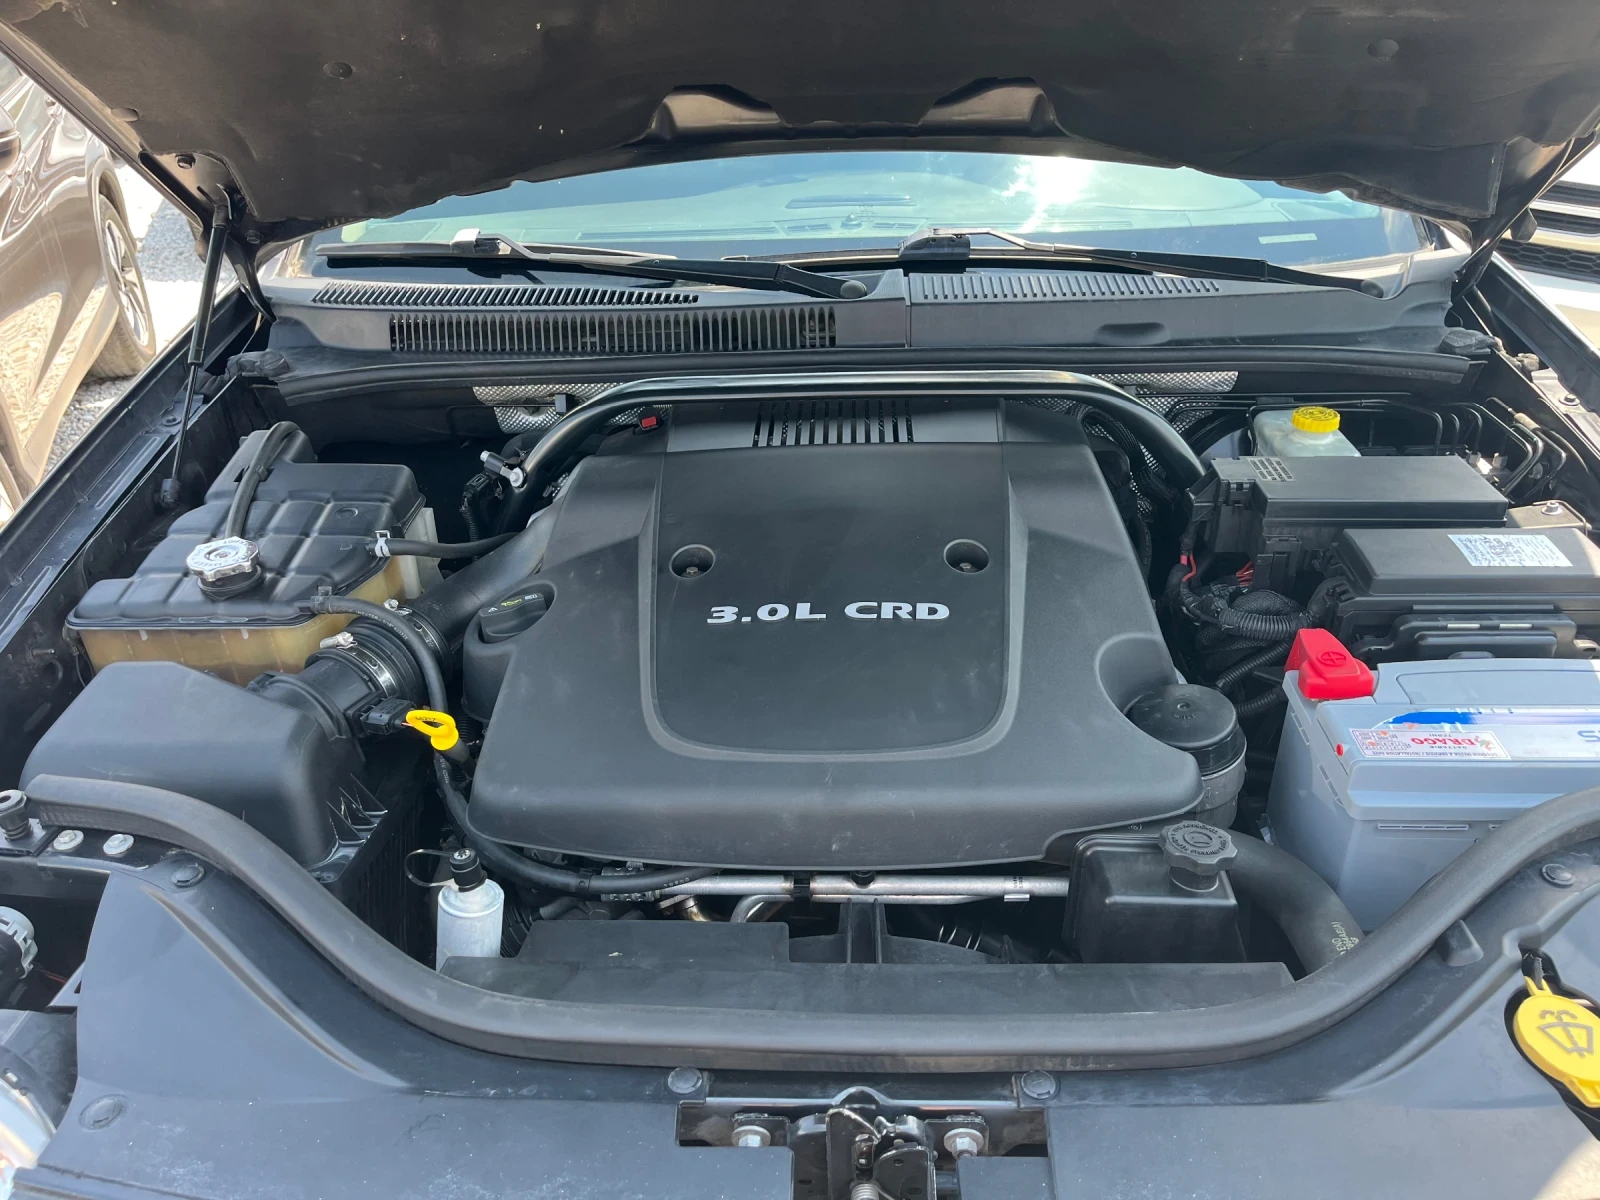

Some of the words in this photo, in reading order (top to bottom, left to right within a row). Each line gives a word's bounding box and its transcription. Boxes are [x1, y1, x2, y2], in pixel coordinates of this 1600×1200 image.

[707, 603, 827, 623] 3.0L
[844, 602, 950, 620] CRD
[1411, 737, 1476, 746] DRAGO
